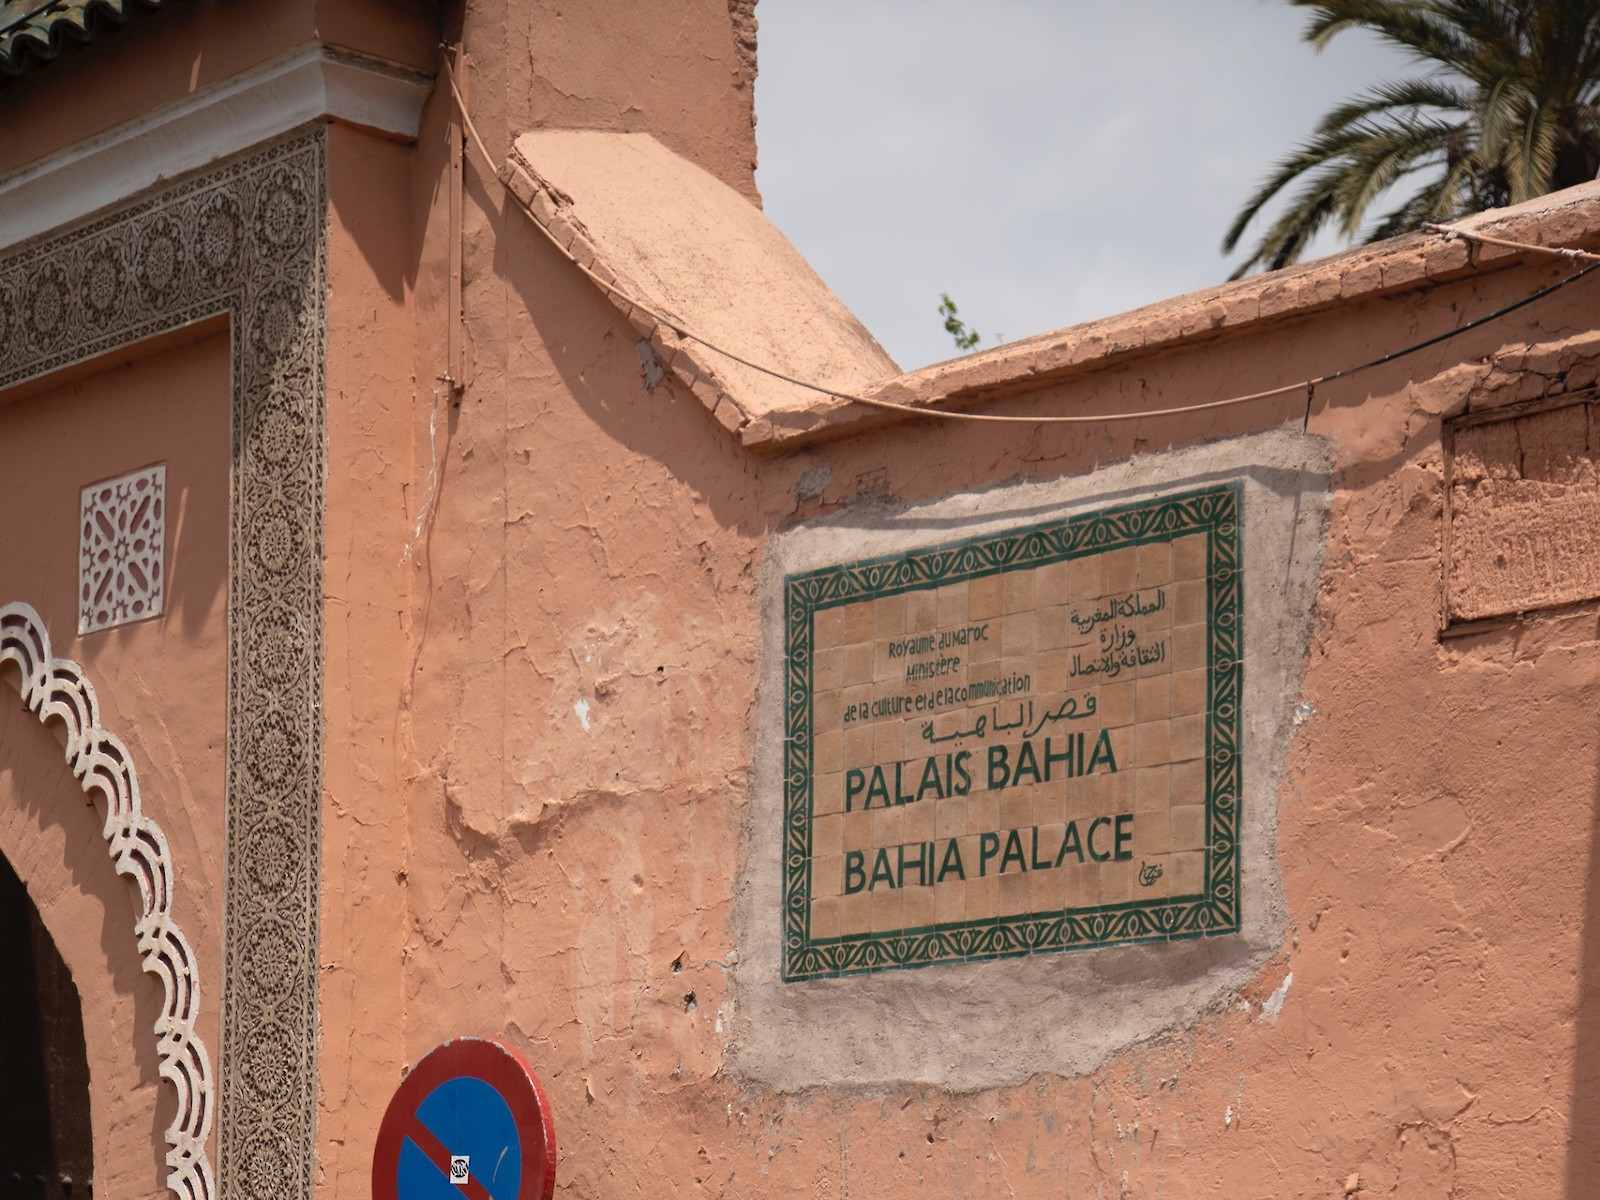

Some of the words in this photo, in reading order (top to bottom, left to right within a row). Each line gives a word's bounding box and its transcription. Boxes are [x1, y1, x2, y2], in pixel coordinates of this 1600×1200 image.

[1070, 598, 1117, 635] المغربية
[1117, 588, 1165, 617] المملكة
[1100, 624, 1136, 653] وزارة
[1119, 640, 1165, 668] الثقافة
[843, 704, 857, 723] de
[859, 702, 869, 720] la
[871, 695, 913, 716] culture
[915, 693, 927, 711] et
[928, 690, 943, 710] de
[954, 671, 1031, 702] communication
[1022, 691, 1097, 739] قصر
[922, 700, 1033, 747] الباهية
[845, 750, 972, 812] PALAIS
[987, 729, 1117, 790] BAHIA
[845, 837, 966, 895] BAHIA
[979, 813, 1134, 877] PALACE
